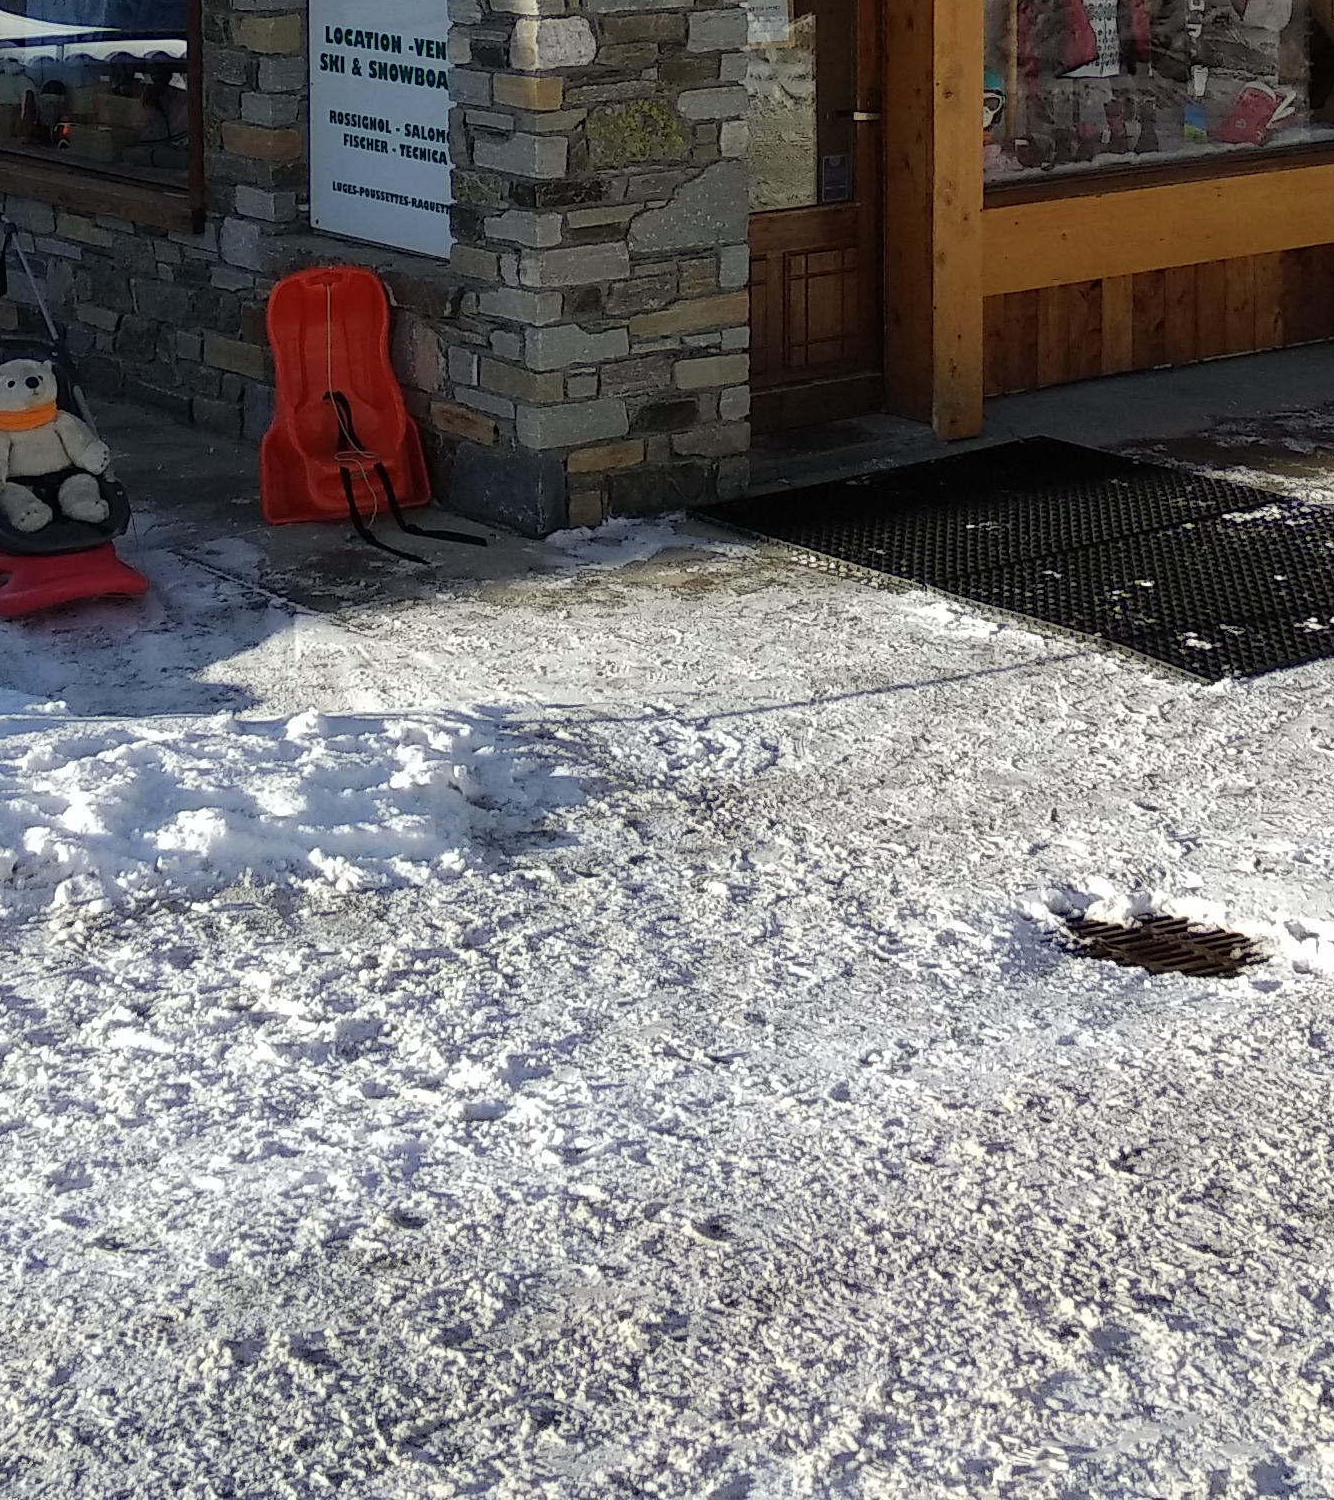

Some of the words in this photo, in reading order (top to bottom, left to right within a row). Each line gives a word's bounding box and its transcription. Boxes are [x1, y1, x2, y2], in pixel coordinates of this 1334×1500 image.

[325, 25, 402, 55] LOCATION
[319, 52, 346, 74] SKI
[351, 57, 363, 77] &
[329, 109, 392, 135] ROSSIGNOL
[404, 123, 450, 144] SALOM
[343, 133, 389, 155] FISCHER
